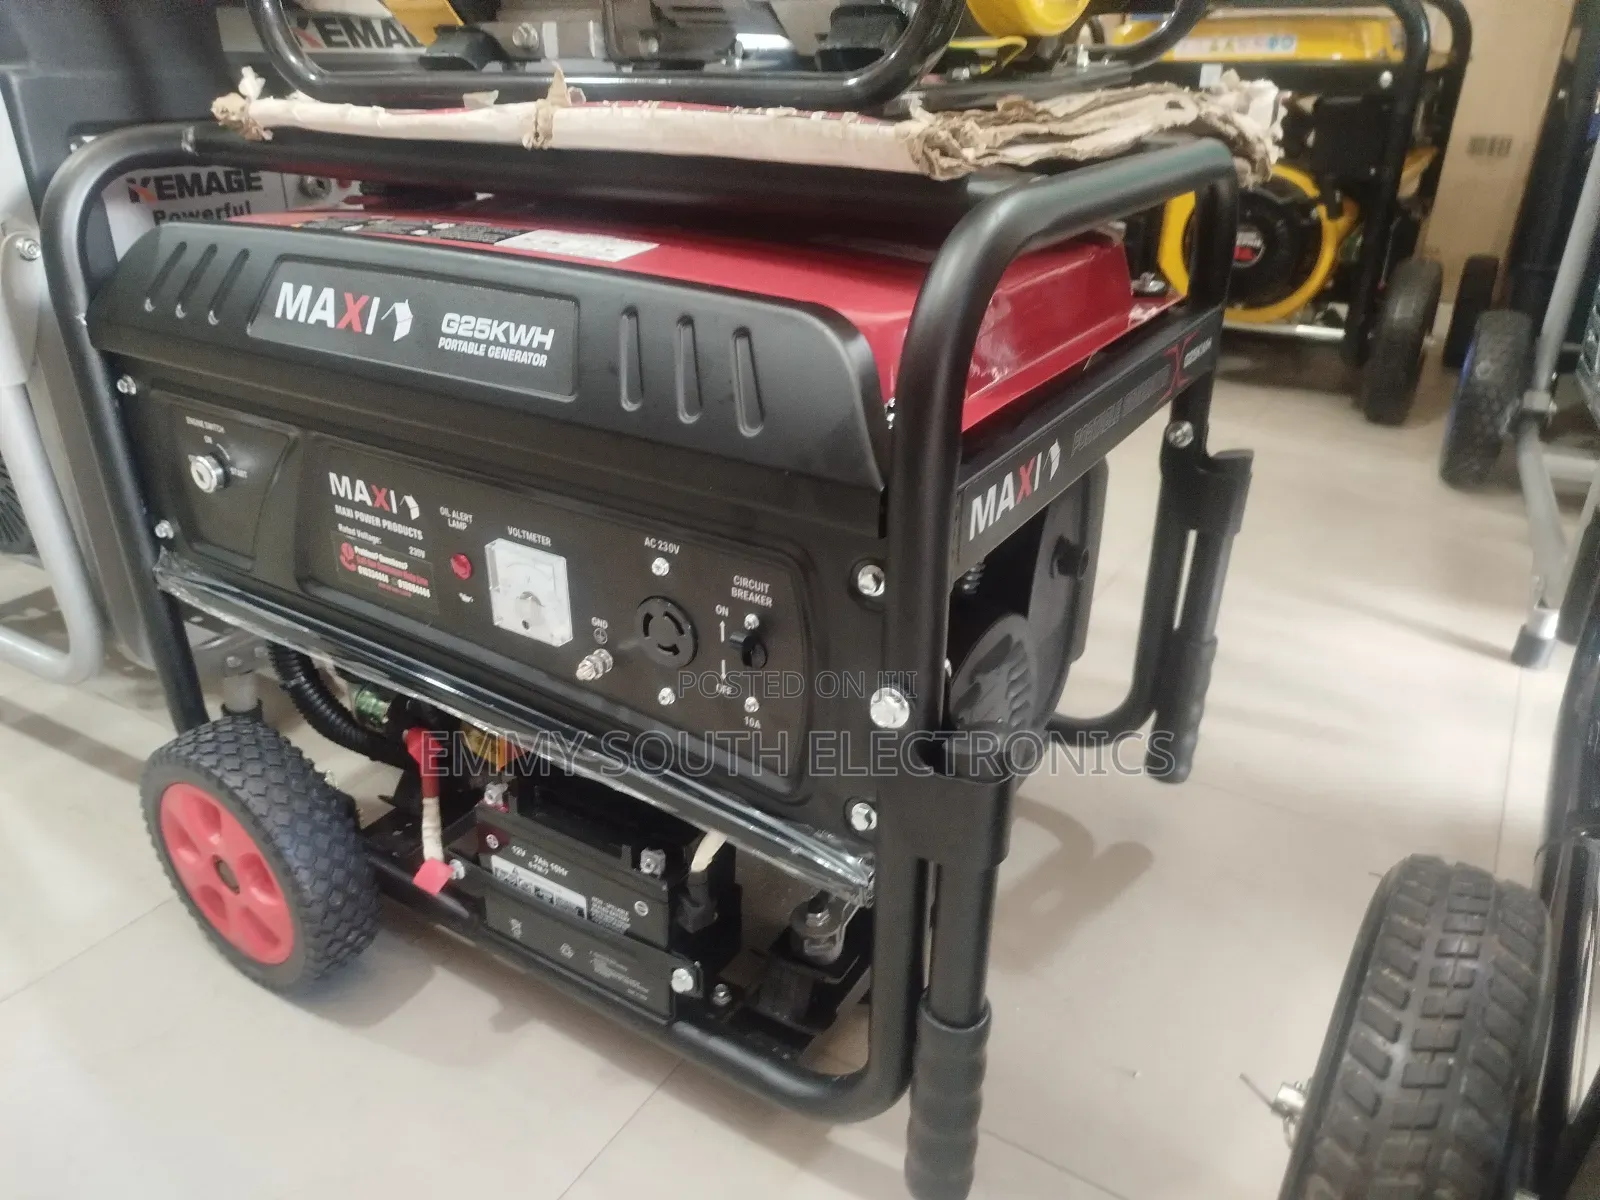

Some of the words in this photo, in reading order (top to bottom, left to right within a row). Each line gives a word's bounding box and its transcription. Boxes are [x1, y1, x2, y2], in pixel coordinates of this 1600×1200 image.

[126, 169, 263, 206] KEMAGE
[275, 282, 380, 335] MAXI
[441, 312, 555, 350] G25KWH
[438, 337, 486, 356] PORTABLE
[487, 345, 548, 368] GENERATOR
[328, 471, 398, 515] MAXI
[969, 451, 1043, 542] MAXI
[334, 504, 354, 519] MAXI
[354, 510, 382, 528] POWER
[381, 519, 424, 540] PRODUCTS
[440, 506, 452, 517] OIL
[452, 510, 473, 524] ALERT
[448, 518, 467, 531] LAMP
[507, 525, 552, 547] VOLTMETER
[644, 537, 656, 549] AC
[657, 540, 680, 555] 230V
[733, 575, 770, 594] CIRCUIT
[731, 587, 773, 607] BREAKER
[715, 604, 729, 617] ON
[591, 616, 608, 630] GND
[744, 716, 761, 729] 10A
